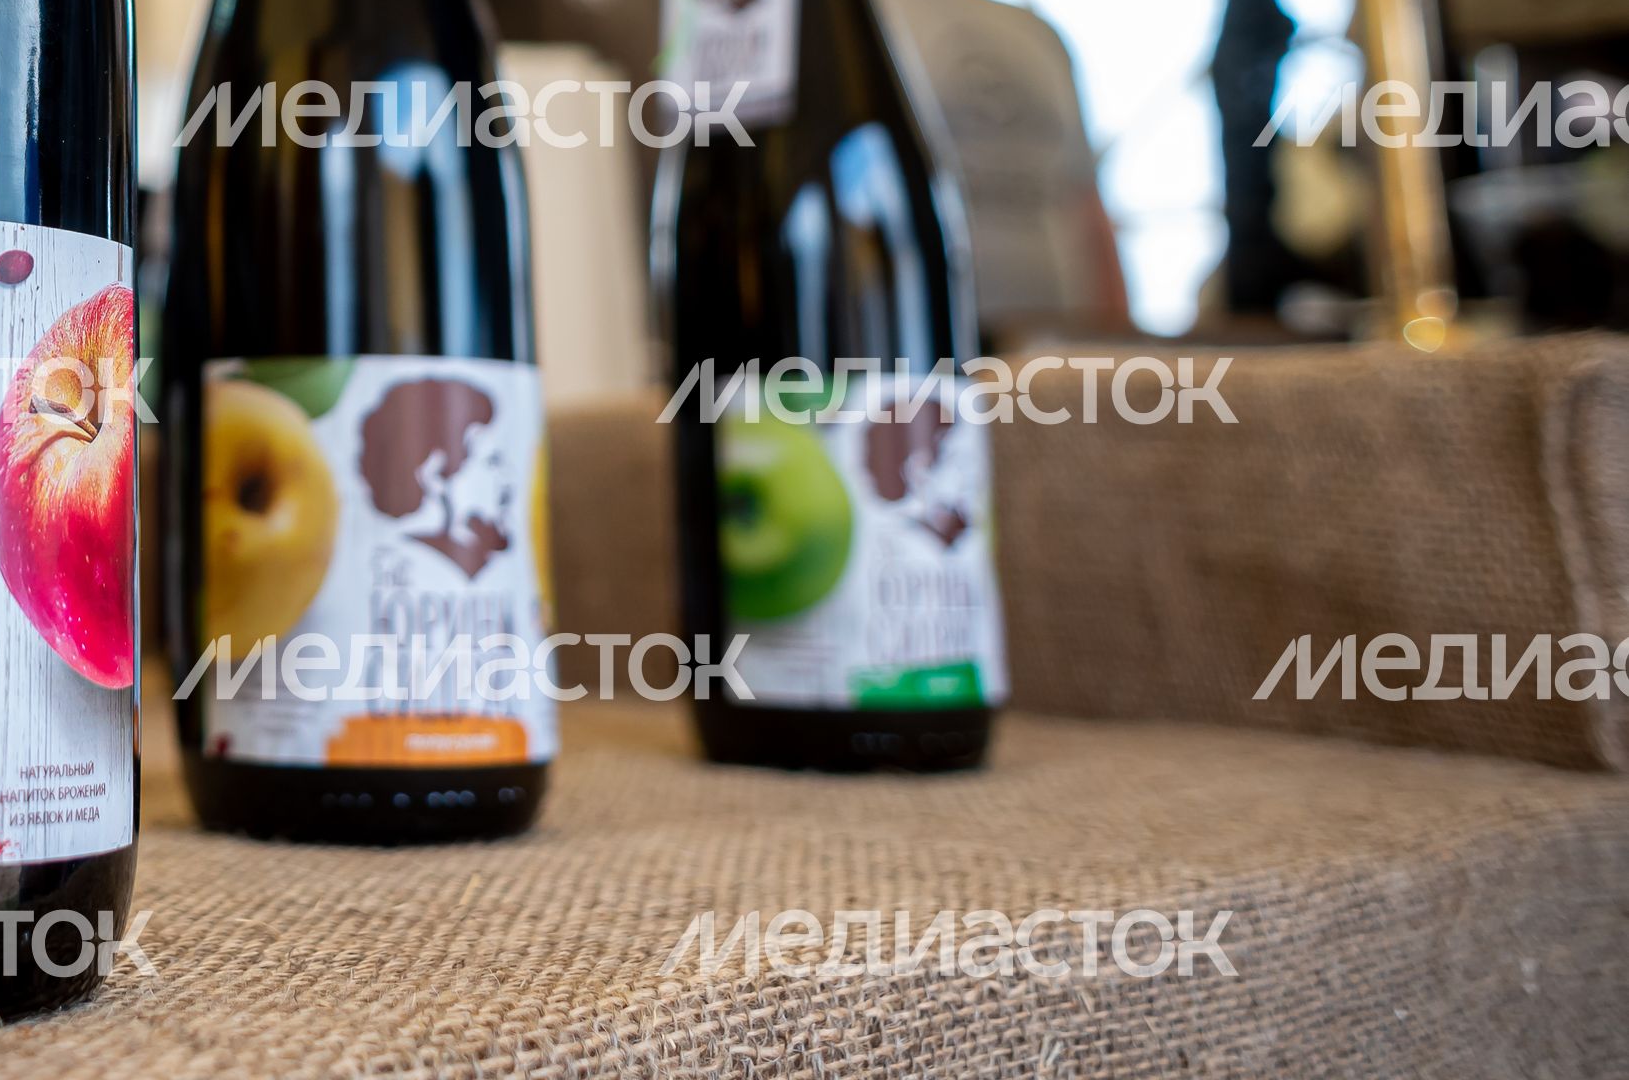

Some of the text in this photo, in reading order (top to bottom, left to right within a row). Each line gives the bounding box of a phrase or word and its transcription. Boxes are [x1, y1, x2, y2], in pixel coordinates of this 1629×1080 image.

[20, 760, 94, 780] НАТУРАЛЬНЫЙ
[0, 782, 106, 804] НАПИТОК БРОЖЕНИЯ
[10, 806, 100, 826] ИЗ ЯБЛОК И МЕДА
